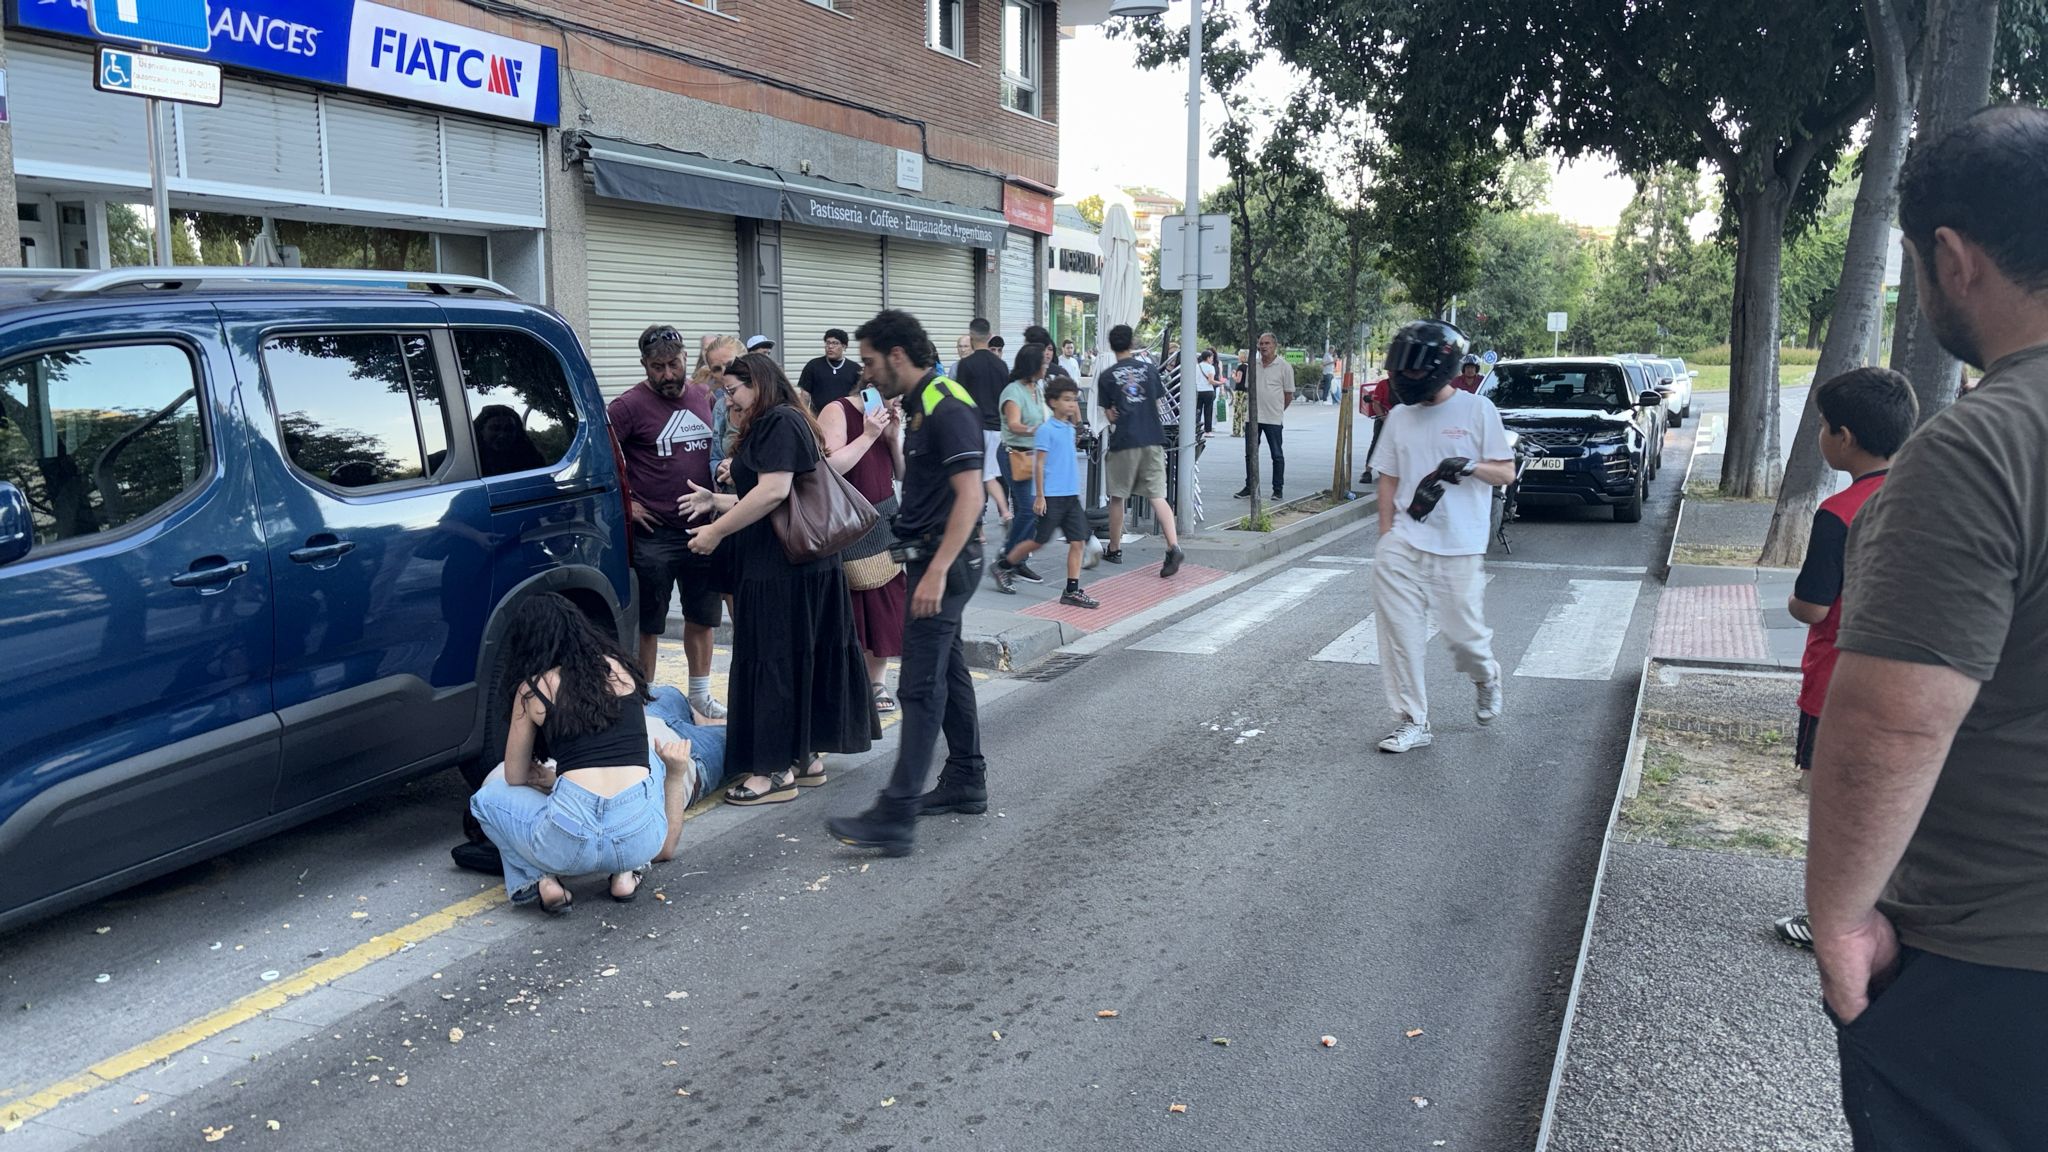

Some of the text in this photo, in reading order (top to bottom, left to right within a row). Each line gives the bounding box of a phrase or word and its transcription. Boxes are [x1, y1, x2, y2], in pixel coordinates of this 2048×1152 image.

[371, 26, 485, 88] FIATC
[810, 199, 993, 243] Pastisseria Coffee Empanadas Argentinas
[680, 423, 705, 433] toldos
[684, 440, 708, 452] JMG
[1542, 459, 1561, 468] MGD
